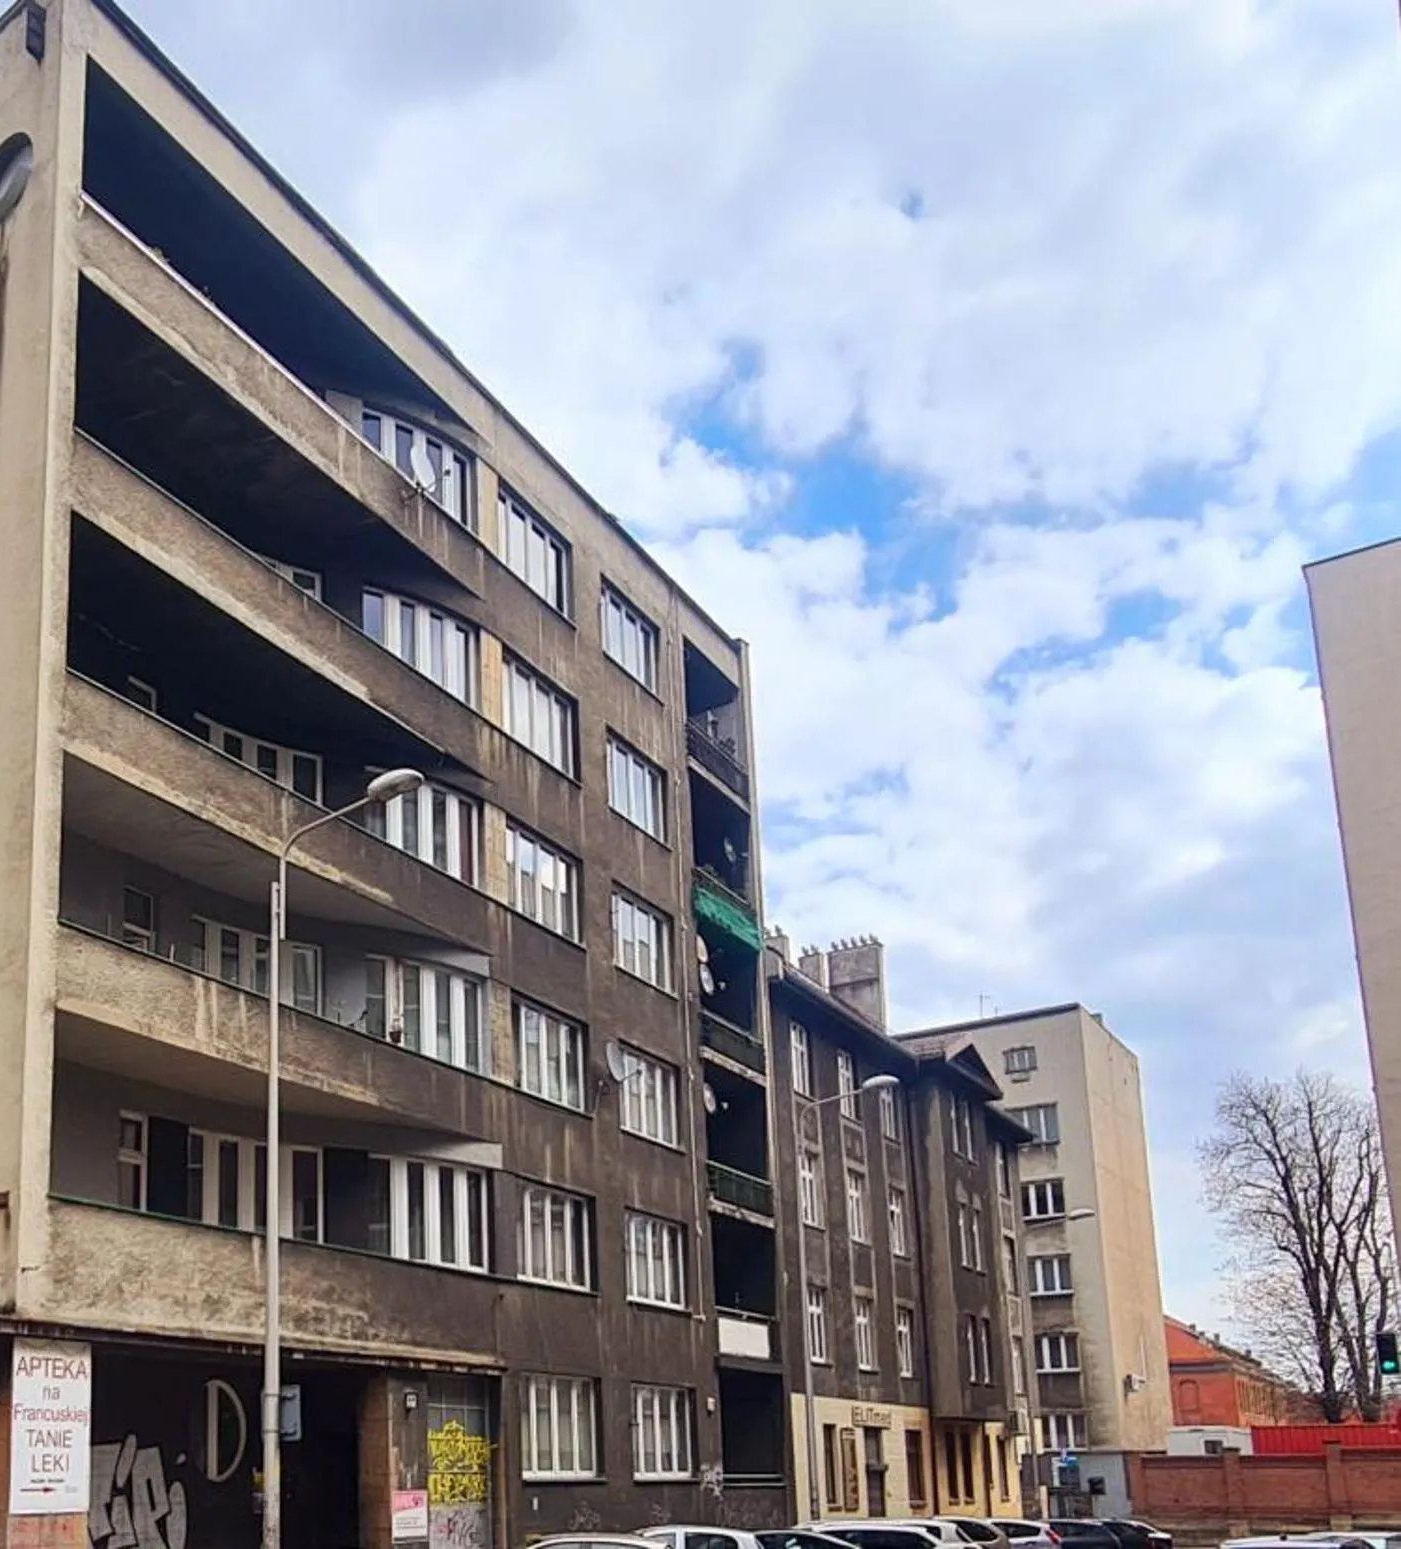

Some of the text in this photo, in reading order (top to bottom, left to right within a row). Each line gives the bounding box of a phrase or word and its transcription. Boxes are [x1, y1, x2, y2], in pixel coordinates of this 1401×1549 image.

[16, 1356, 88, 1379] APTEKA
[42, 1386, 61, 1400] na
[14, 1404, 88, 1426] Francuskiej
[26, 1430, 73, 1448] TANIE
[32, 1454, 70, 1473] LEKI
